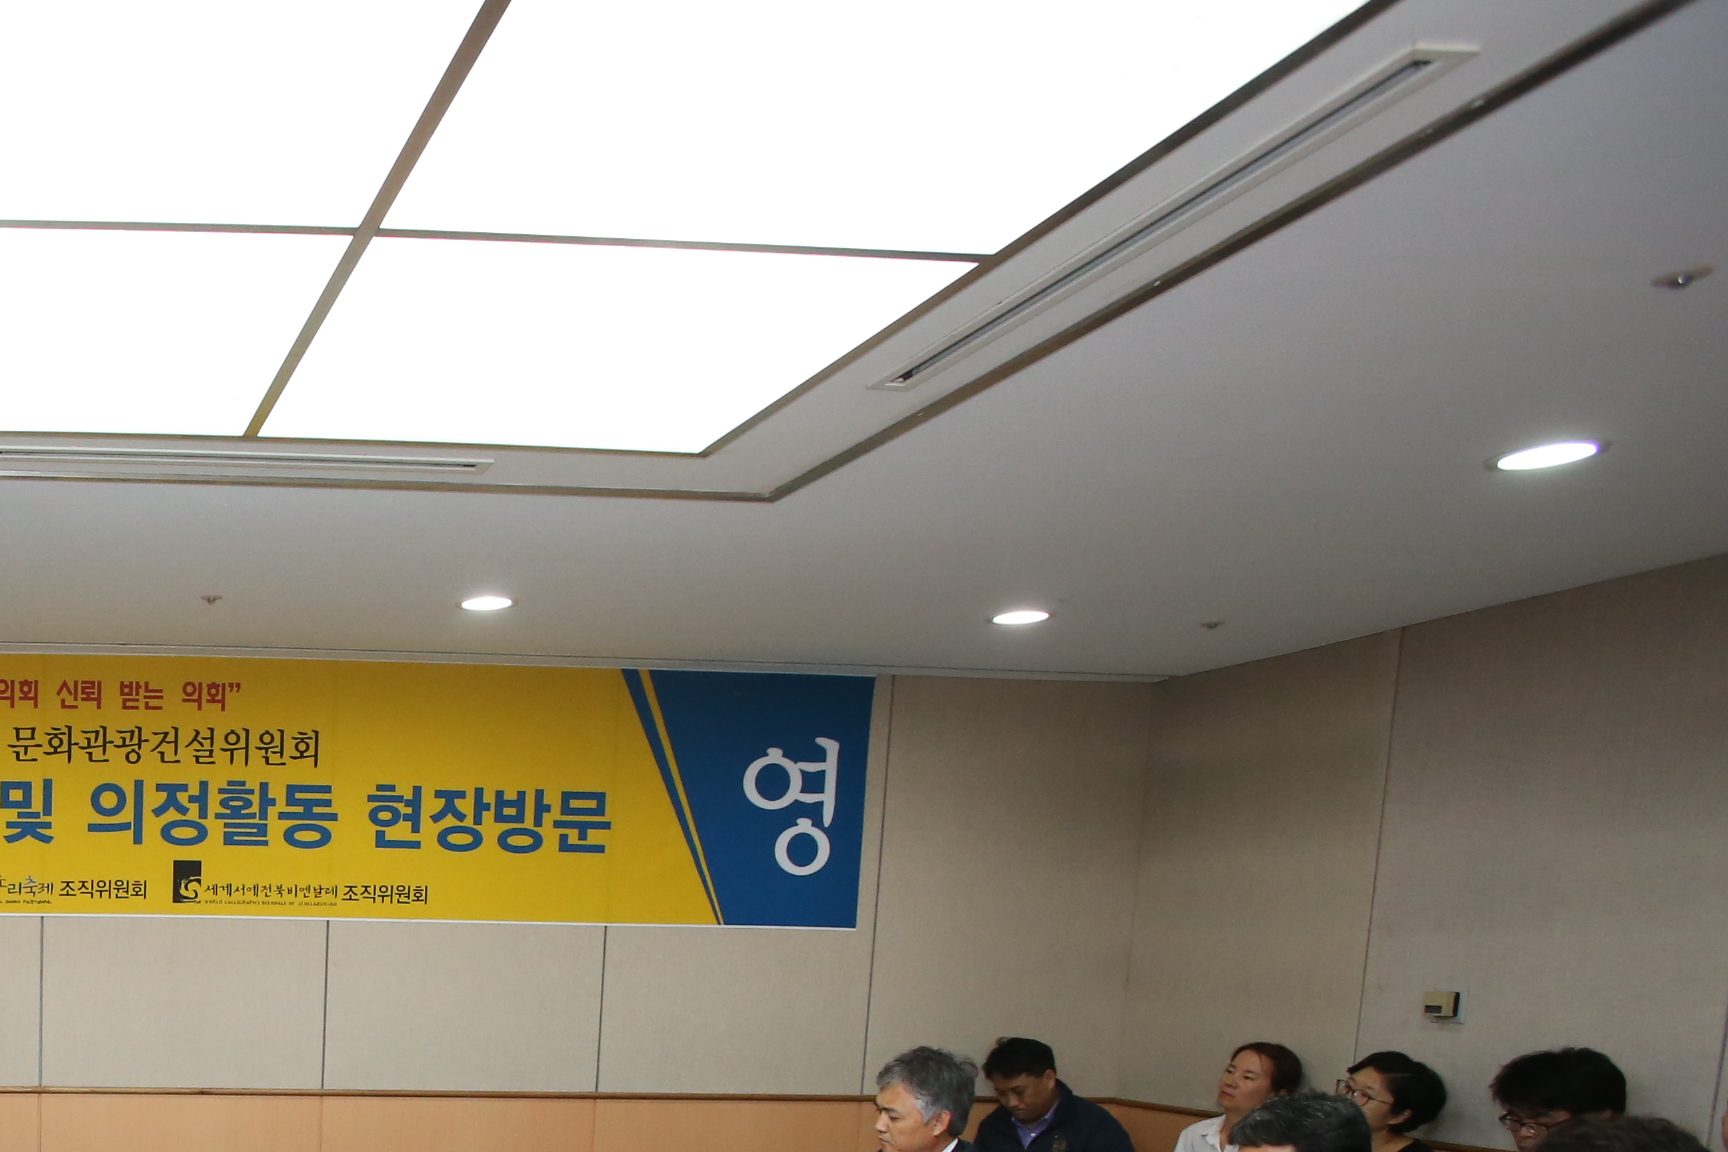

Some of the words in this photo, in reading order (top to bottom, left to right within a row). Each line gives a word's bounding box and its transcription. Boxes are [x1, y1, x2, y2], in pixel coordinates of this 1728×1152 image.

[56, 679, 103, 711] 신뢰
[119, 680, 164, 711] 받는
[7, 723, 321, 768] 문화관광건설위원회
[0, 778, 55, 844] 및
[87, 779, 339, 850] 의정활동
[366, 784, 612, 854] 현장방문
[742, 737, 841, 876] 영
[58, 879, 147, 899] 조직위원회
[341, 885, 428, 905] 조직위원회
